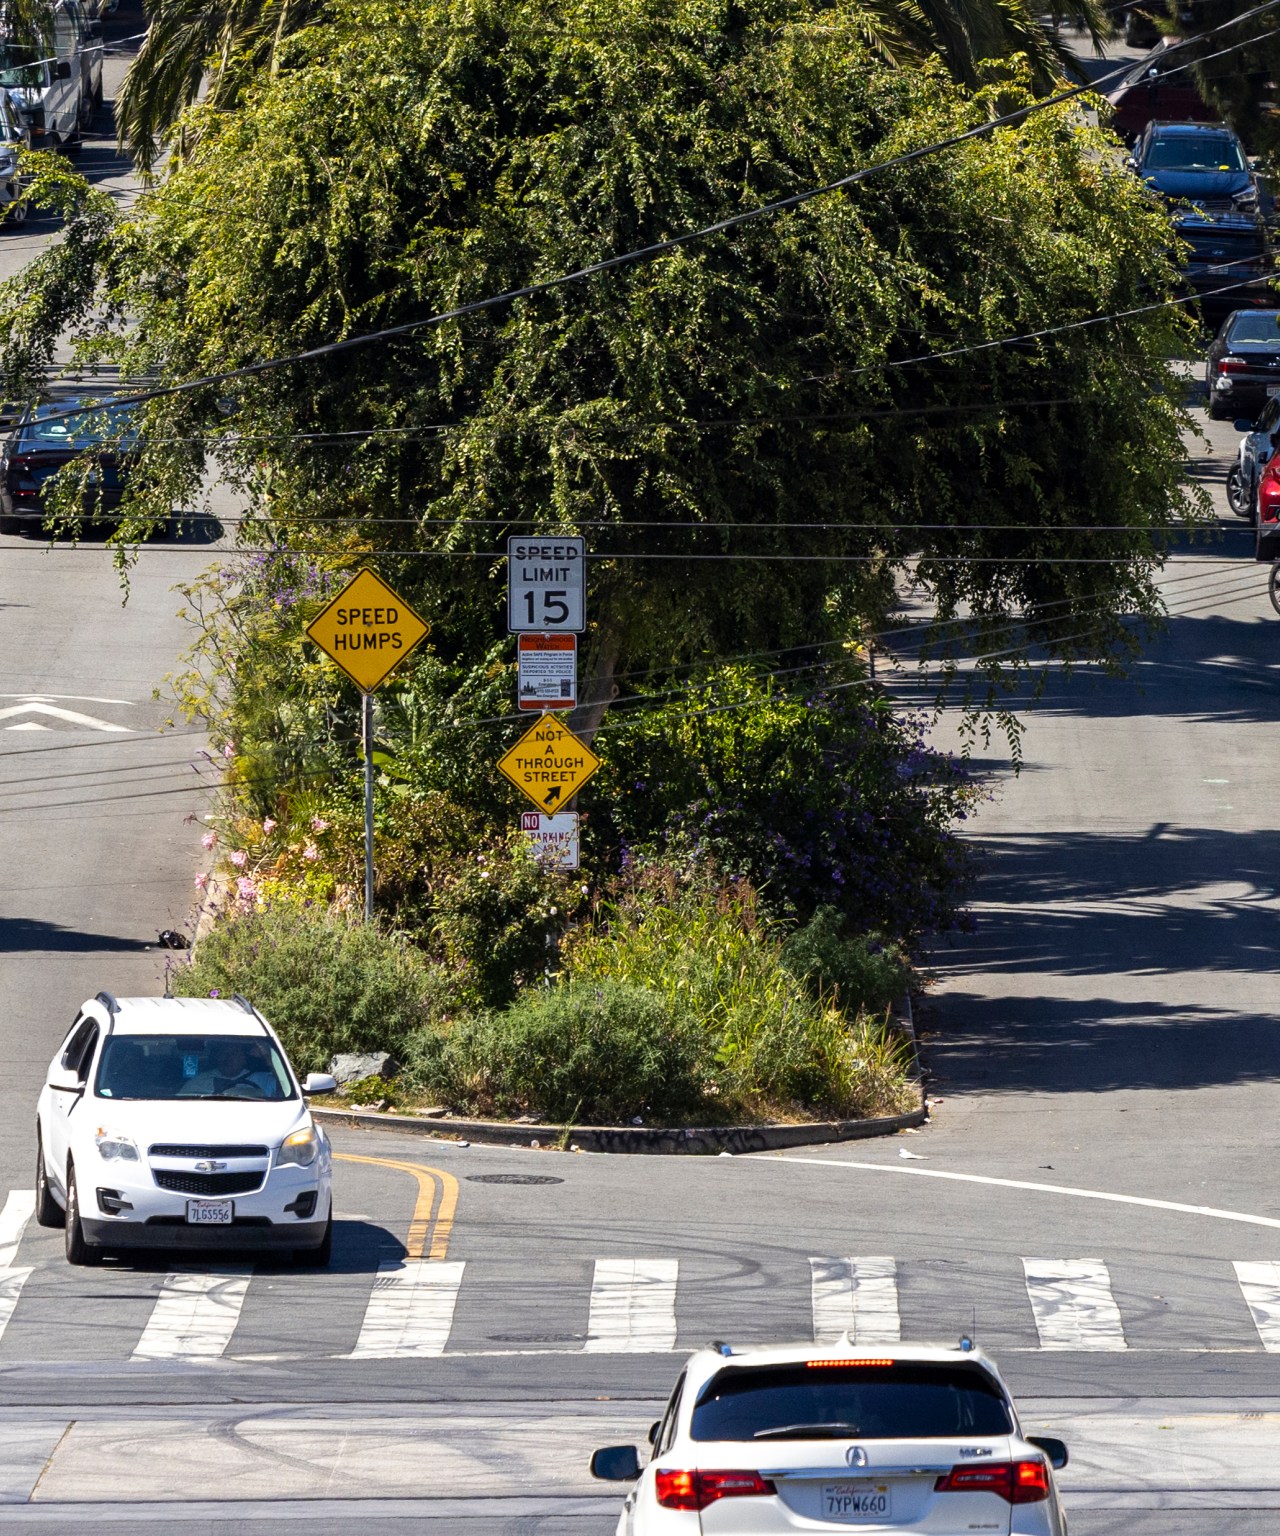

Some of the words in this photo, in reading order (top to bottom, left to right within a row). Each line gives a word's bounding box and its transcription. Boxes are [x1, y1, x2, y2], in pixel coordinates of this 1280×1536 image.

[515, 546, 579, 561] SPEED
[522, 567, 570, 582] LIMIT
[523, 590, 570, 624] 15
[336, 608, 398, 626] SPEED
[334, 632, 403, 651] HUMPS
[535, 730, 564, 742] NOT
[544, 744, 555, 755] A
[515, 757, 584, 769] THROUGH
[523, 771, 577, 783] STREET
[524, 815, 538, 828] NO
[191, 1208, 229, 1221] 7LGS556
[826, 1496, 886, 1513] 7YPW660
